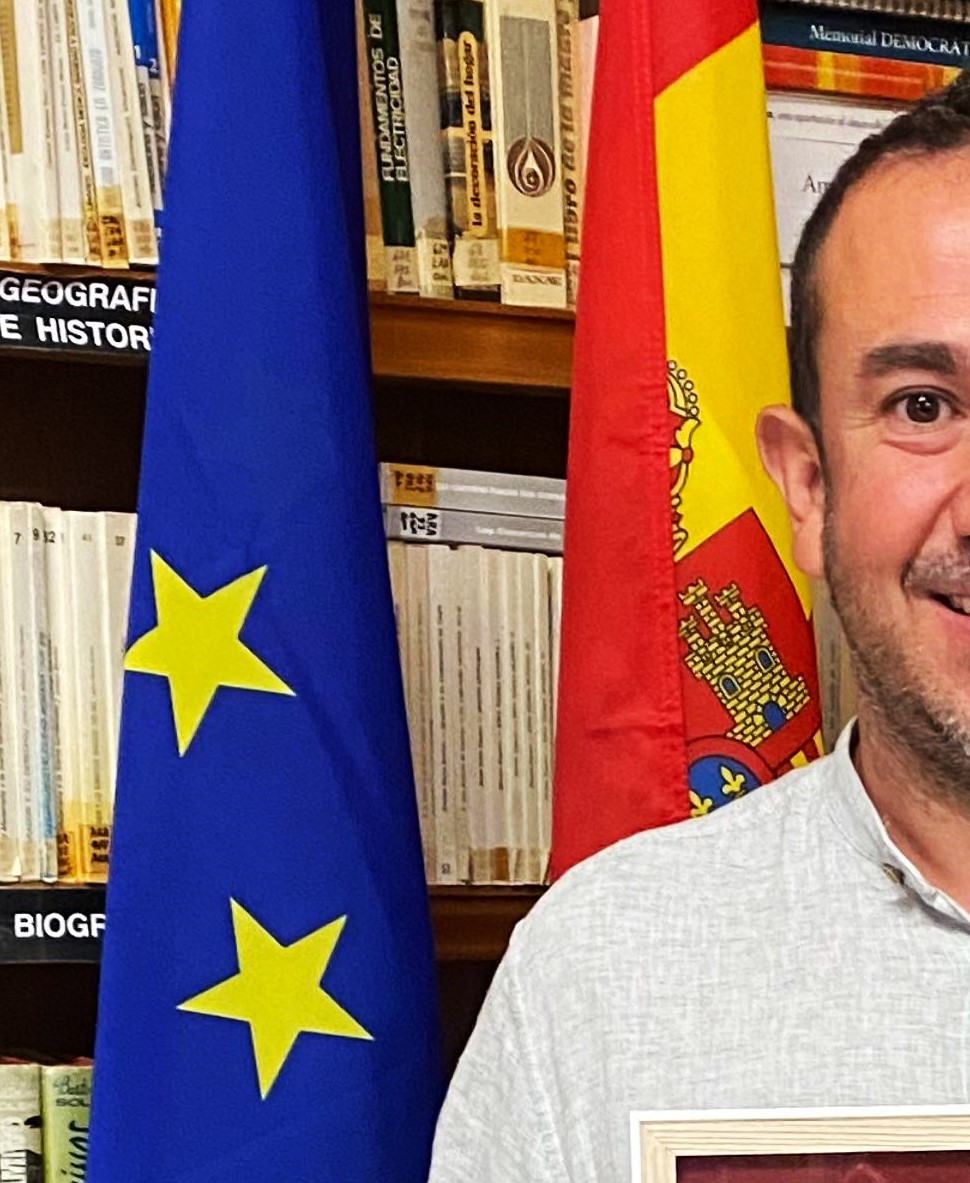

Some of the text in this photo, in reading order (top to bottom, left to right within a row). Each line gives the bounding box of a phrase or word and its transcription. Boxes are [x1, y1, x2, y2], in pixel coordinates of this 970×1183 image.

[809, 25, 877, 47] Memorial
[368, 14, 395, 181] FUNDAMENTOS DE
[465, 92, 475, 115] del
[387, 57, 408, 181] ELECTRICIDAD
[472, 213, 482, 227] la
[0, 314, 154, 350] E HISTOR
